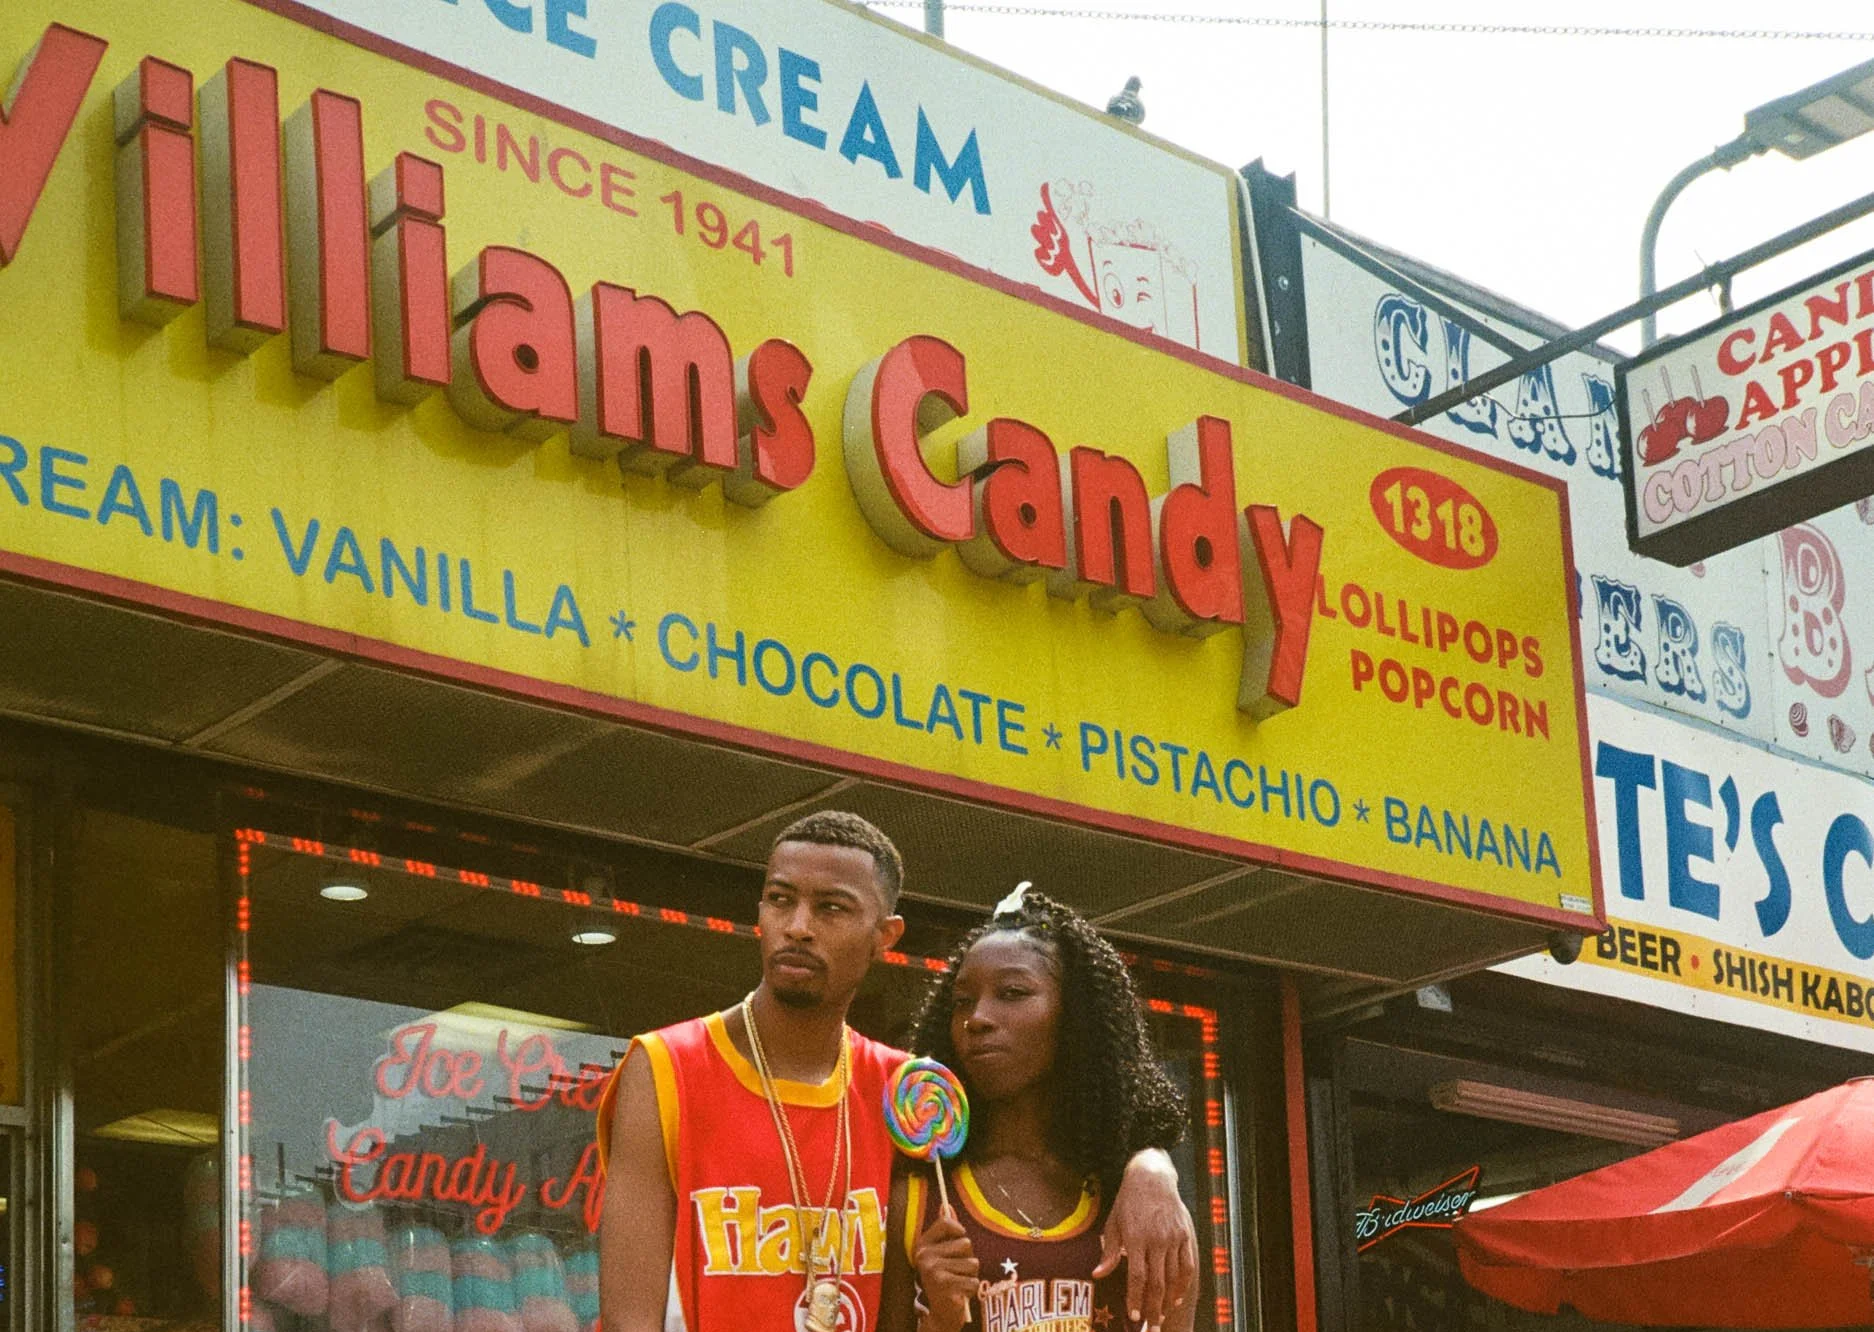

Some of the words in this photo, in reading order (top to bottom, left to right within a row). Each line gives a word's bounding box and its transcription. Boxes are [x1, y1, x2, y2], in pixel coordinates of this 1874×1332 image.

[649, 1, 991, 216] CREAM
[424, 98, 638, 217] SINCE
[661, 189, 797, 279] 1941
[866, 334, 1324, 708] Candy
[1382, 480, 1485, 557] 1318
[1643, 406, 1818, 524] COTTON
[1315, 574, 1545, 678] LOLLIPOPS
[1575, 567, 1752, 720] ERS
[1778, 522, 1874, 700] B
[270, 507, 590, 649] VANILLA
[658, 611, 1031, 756] CHOCOLATE
[1080, 722, 1342, 828] PISTACHIO
[1383, 797, 1562, 879] BANANA
[1352, 647, 1549, 741] POPCORN
[1596, 924, 1681, 977] BEER
[1713, 948, 1795, 1004] SHISH
[375, 1023, 486, 1100] Ice
[497, 1029, 616, 1111] Cre
[327, 1119, 528, 1236] Candy
[541, 1141, 606, 1234] A
[1355, 1190, 1476, 1239] Budweiser
